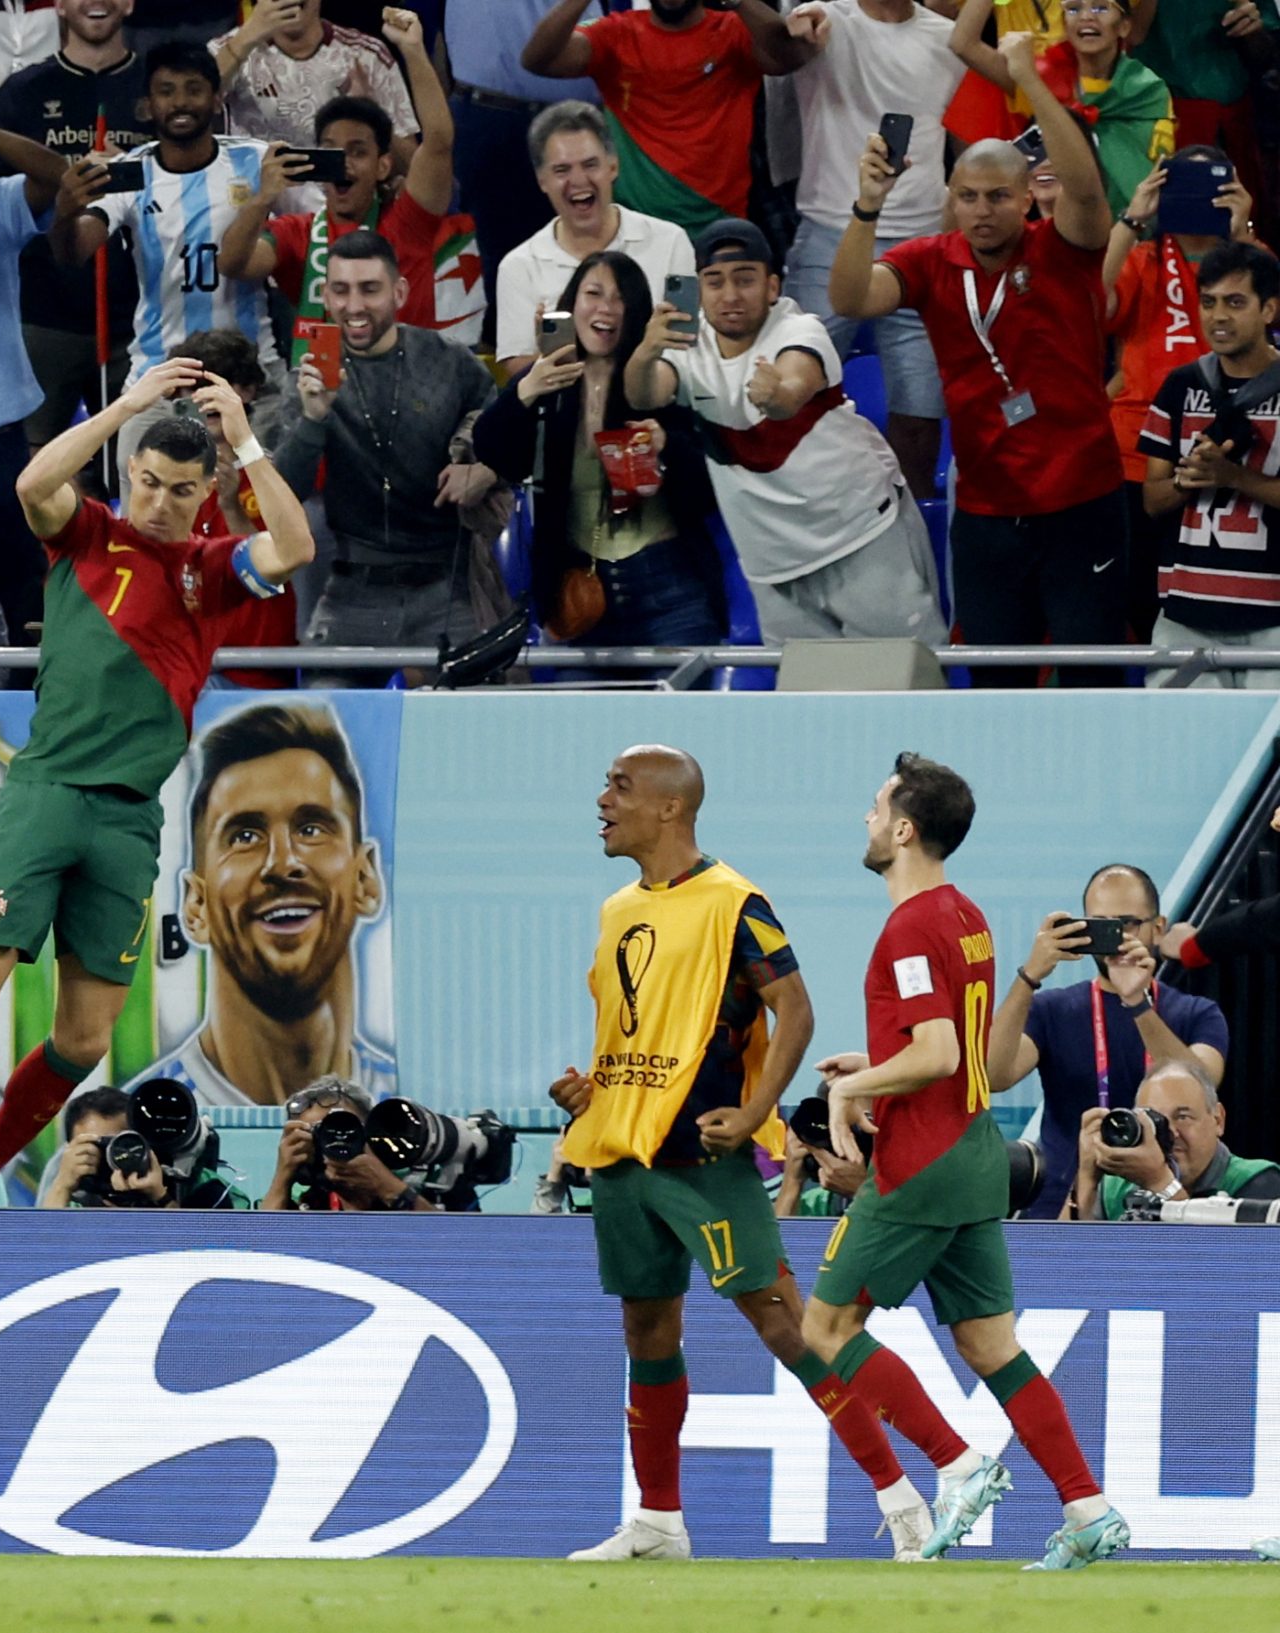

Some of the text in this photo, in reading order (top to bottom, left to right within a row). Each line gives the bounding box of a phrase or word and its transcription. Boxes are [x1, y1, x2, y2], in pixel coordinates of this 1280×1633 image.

[45, 126, 155, 147] Arbejernes
[179, 243, 220, 292] 10
[107, 567, 133, 616] 7
[649, 1054, 679, 1069] CUP
[965, 980, 990, 1113] 10
[700, 1219, 735, 1270] 17
